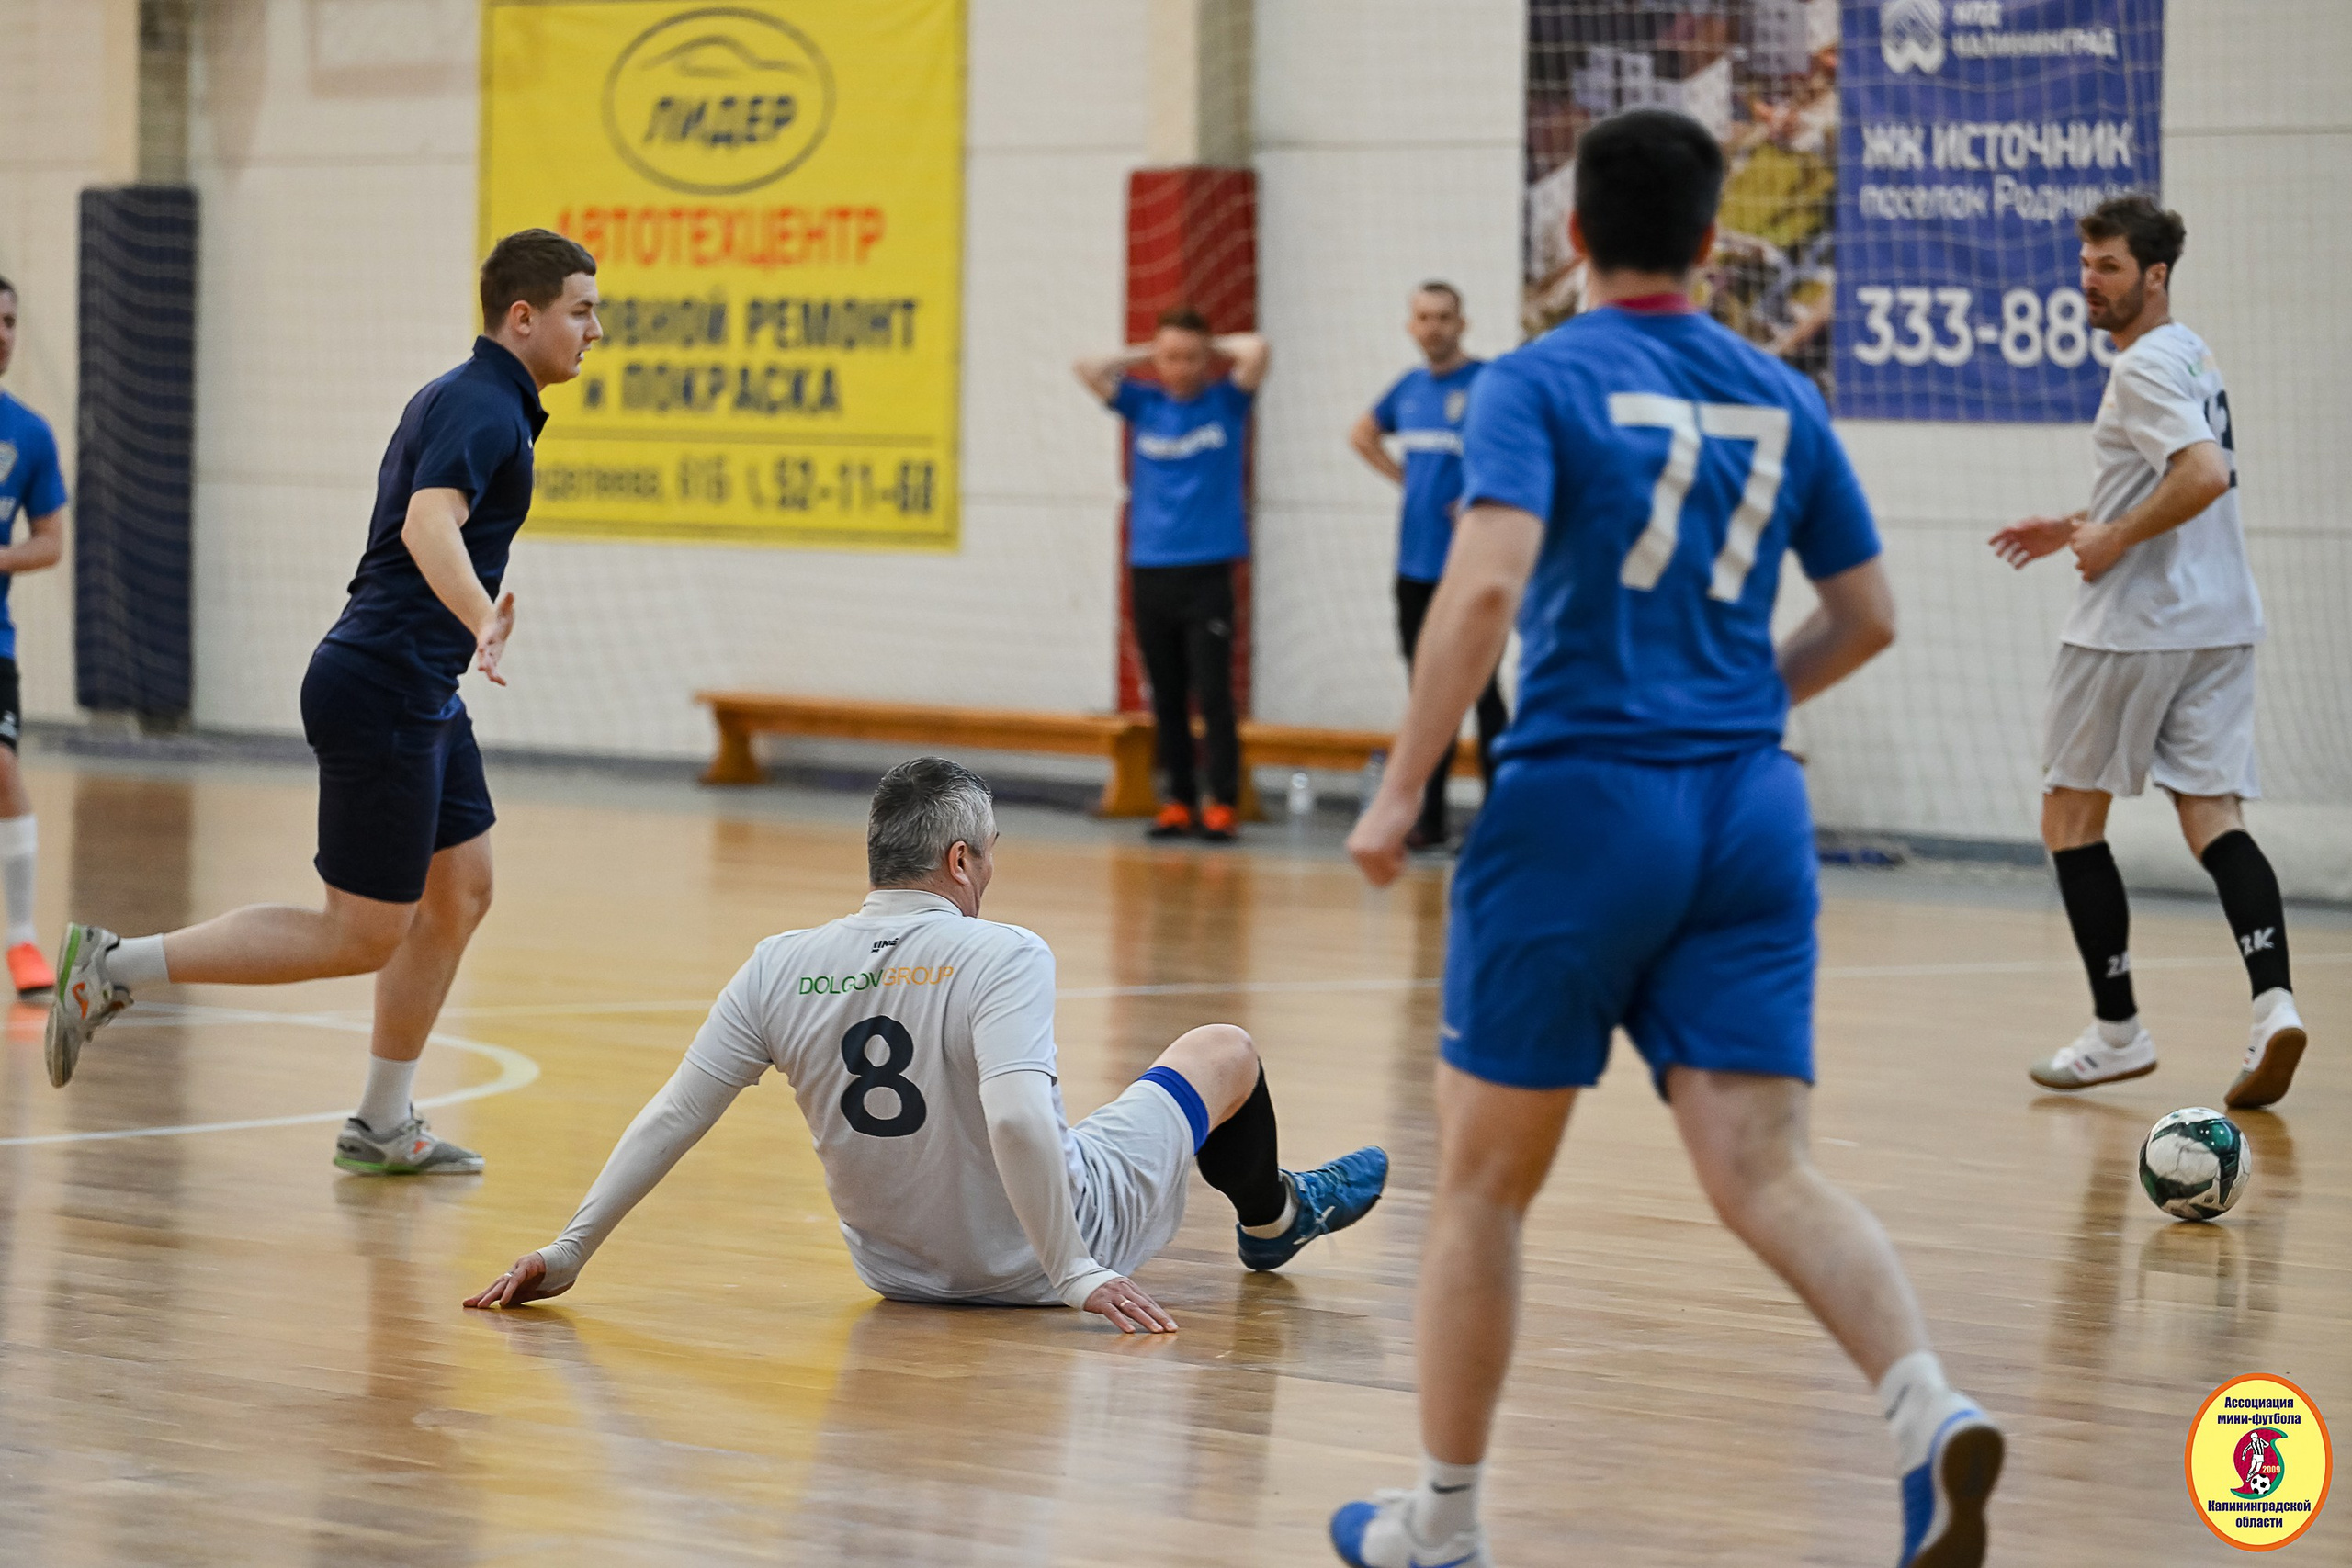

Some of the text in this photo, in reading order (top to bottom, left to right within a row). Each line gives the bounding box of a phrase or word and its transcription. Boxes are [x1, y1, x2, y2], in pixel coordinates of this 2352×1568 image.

[644, 94, 797, 147] ЛИДЕР
[1862, 120, 2134, 171] ЖК ИСТОЧНИК
[1993, 173, 2139, 225] Родни
[594, 286, 918, 350] ОВНОЙ РЕМОНТ
[620, 363, 842, 416] ПОКРАСКА
[1609, 391, 1791, 604] 77
[2240, 926, 2276, 958] 2K
[840, 1014, 927, 1137] 8
